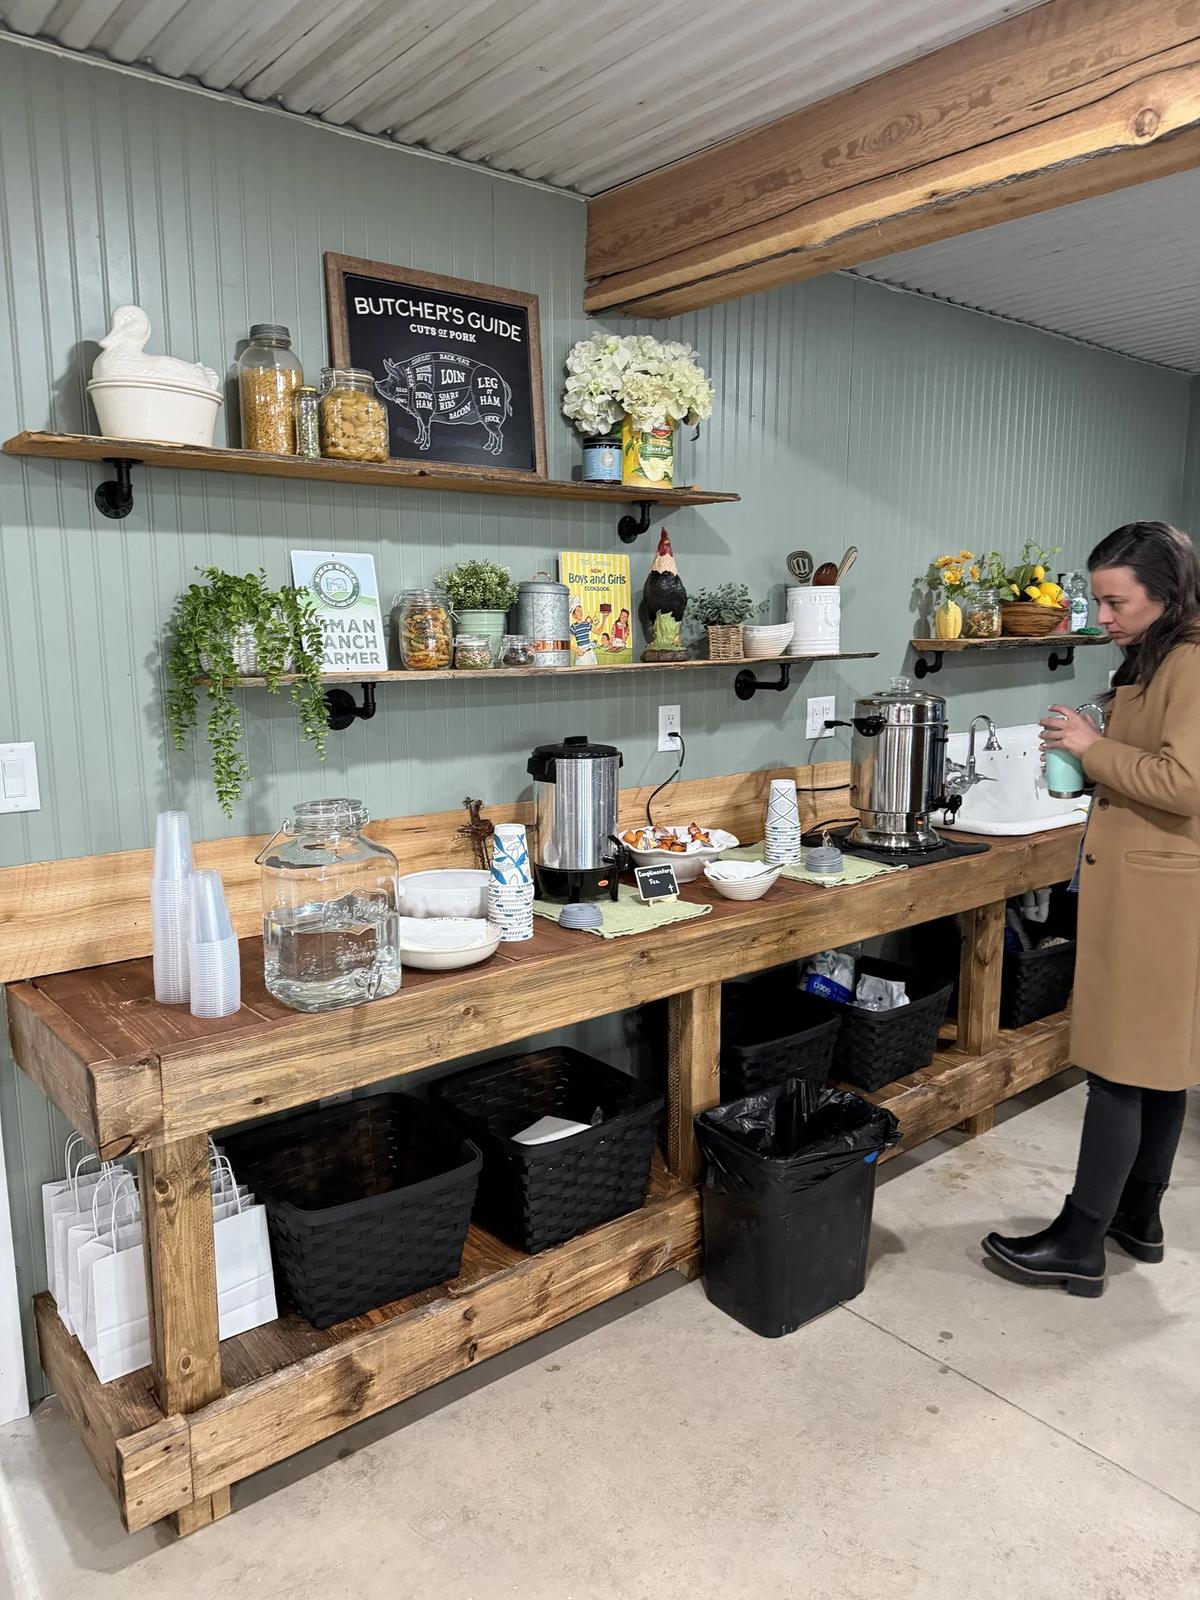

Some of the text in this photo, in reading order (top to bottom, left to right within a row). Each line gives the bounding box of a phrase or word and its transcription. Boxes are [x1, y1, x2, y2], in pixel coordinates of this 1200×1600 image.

[353, 296, 522, 342] BUTCHER'S GUIDE
[409, 323, 437, 336] CUTS
[449, 330, 477, 343] PORK
[439, 353, 456, 361] BACK
[440, 368, 466, 385] LOIN
[477, 376, 499, 389] LEG
[438, 391, 460, 402] SPARE
[480, 395, 502, 407] HAM
[415, 400, 433, 411] HAM
[439, 400, 456, 411] RIBS
[448, 400, 471, 420] BACON
[484, 415, 501, 424] HOCK
[568, 572, 626, 585] Boys and Girls
[323, 634, 378, 649] ANCH
[322, 651, 381, 665] ARMER
